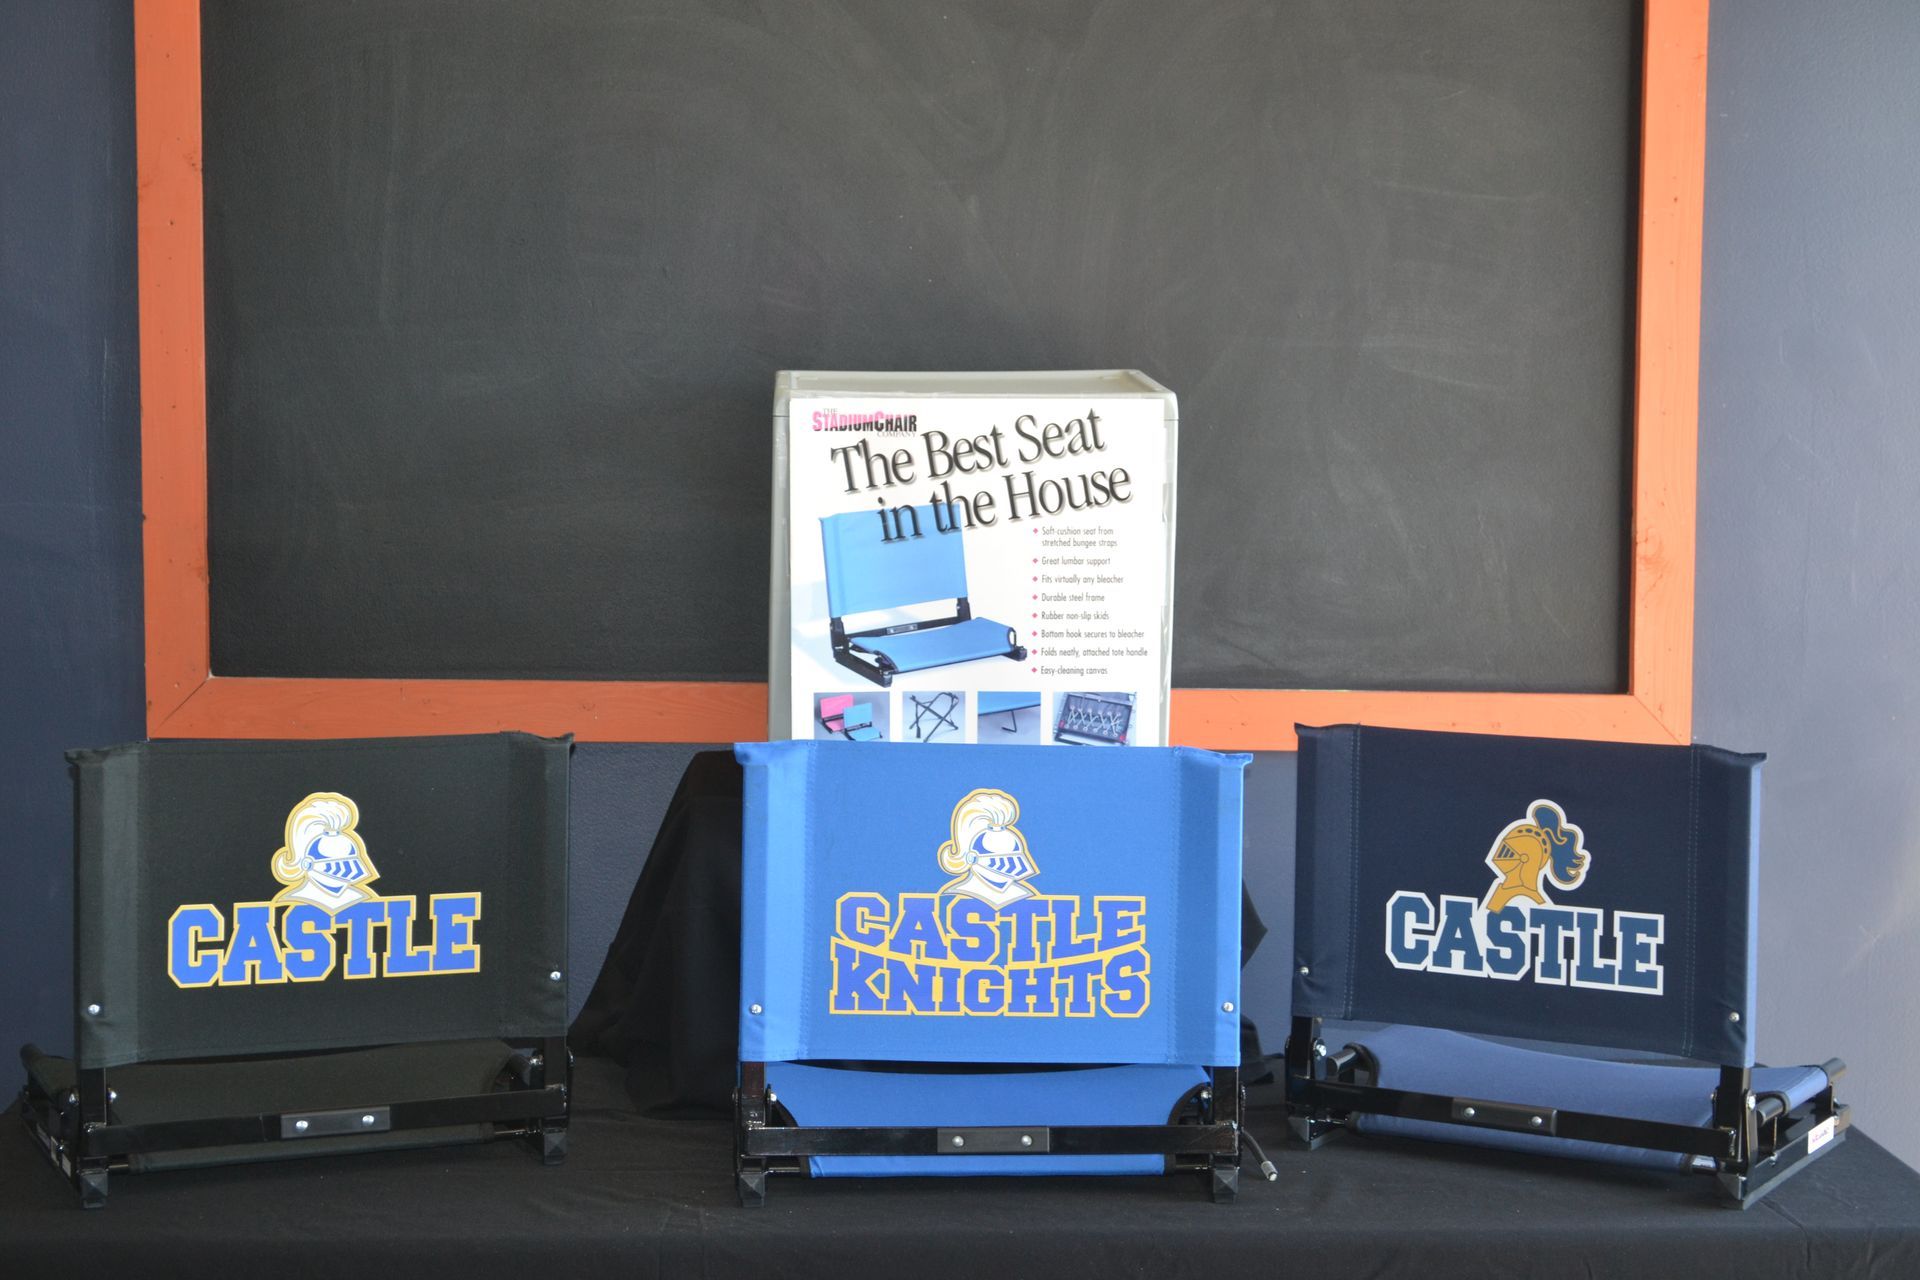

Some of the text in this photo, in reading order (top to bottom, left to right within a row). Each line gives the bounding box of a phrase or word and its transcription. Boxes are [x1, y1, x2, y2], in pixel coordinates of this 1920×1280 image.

[831, 408, 1104, 494] The Best Seat
[876, 467, 1134, 543] in the House
[1083, 527, 1096, 535] seat
[1098, 526, 1114, 535] from
[1042, 538, 1118, 548] stretched bungee straps
[1042, 556, 1111, 567] Great lumbar support
[1042, 575, 1124, 586] Fits virtually any bleacher
[1042, 593, 1105, 602] Durable steel frame
[1042, 611, 1110, 621] Rubber non-slip skids
[1042, 629, 1144, 638] Bottom hook secures to bleacher
[1041, 647, 1148, 658] Folds neatly, attached tote handle
[1086, 667, 1108, 675] canvas
[836, 892, 1146, 966] CASTLE
[168, 892, 481, 988] CASTLE
[1385, 890, 1664, 995] CASTLE
[829, 938, 1150, 1018] KNIGHTS
